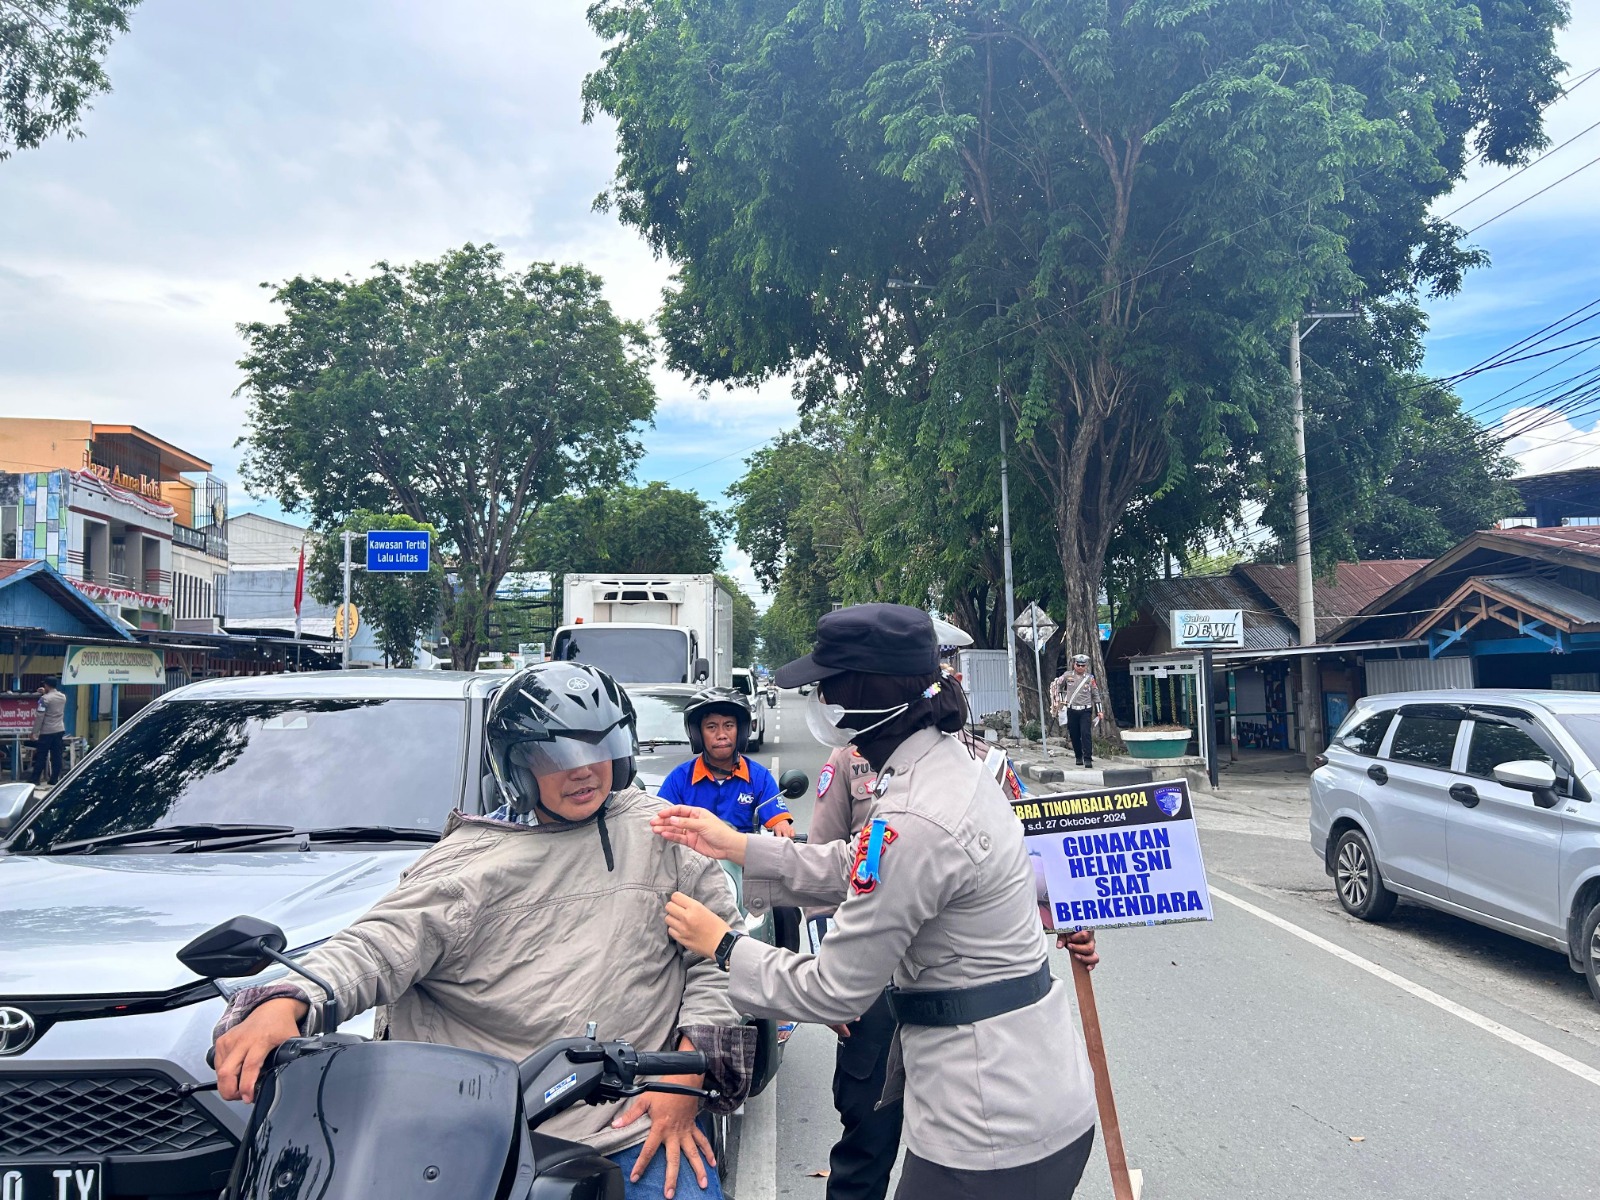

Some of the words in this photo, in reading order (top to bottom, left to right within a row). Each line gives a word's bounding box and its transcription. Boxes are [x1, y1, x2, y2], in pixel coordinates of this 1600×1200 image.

[111, 465, 140, 491] Anna
[370, 540, 403, 550] Kawasan
[405, 540, 427, 550] Tertib
[377, 553, 394, 563] Lalu
[395, 553, 419, 563] Lintas
[1184, 614, 1210, 622] Salon
[1183, 623, 1236, 638] DEWI
[81, 651, 100, 667] SOTO
[1041, 796, 1113, 818] TINOMBALA
[1114, 791, 1148, 810] 2024
[1028, 821, 1045, 831] s.d.
[1045, 819, 1057, 829] 27
[1060, 816, 1101, 828] Oktober
[1103, 812, 1126, 823] 2024
[1062, 828, 1170, 857] GUNAKAN
[1068, 854, 1127, 878] HELM
[1131, 849, 1172, 873] SNI
[1095, 873, 1150, 897] SAAT
[1055, 890, 1203, 922] BERKENDARA
[52, 1169, 95, 1200] TY
